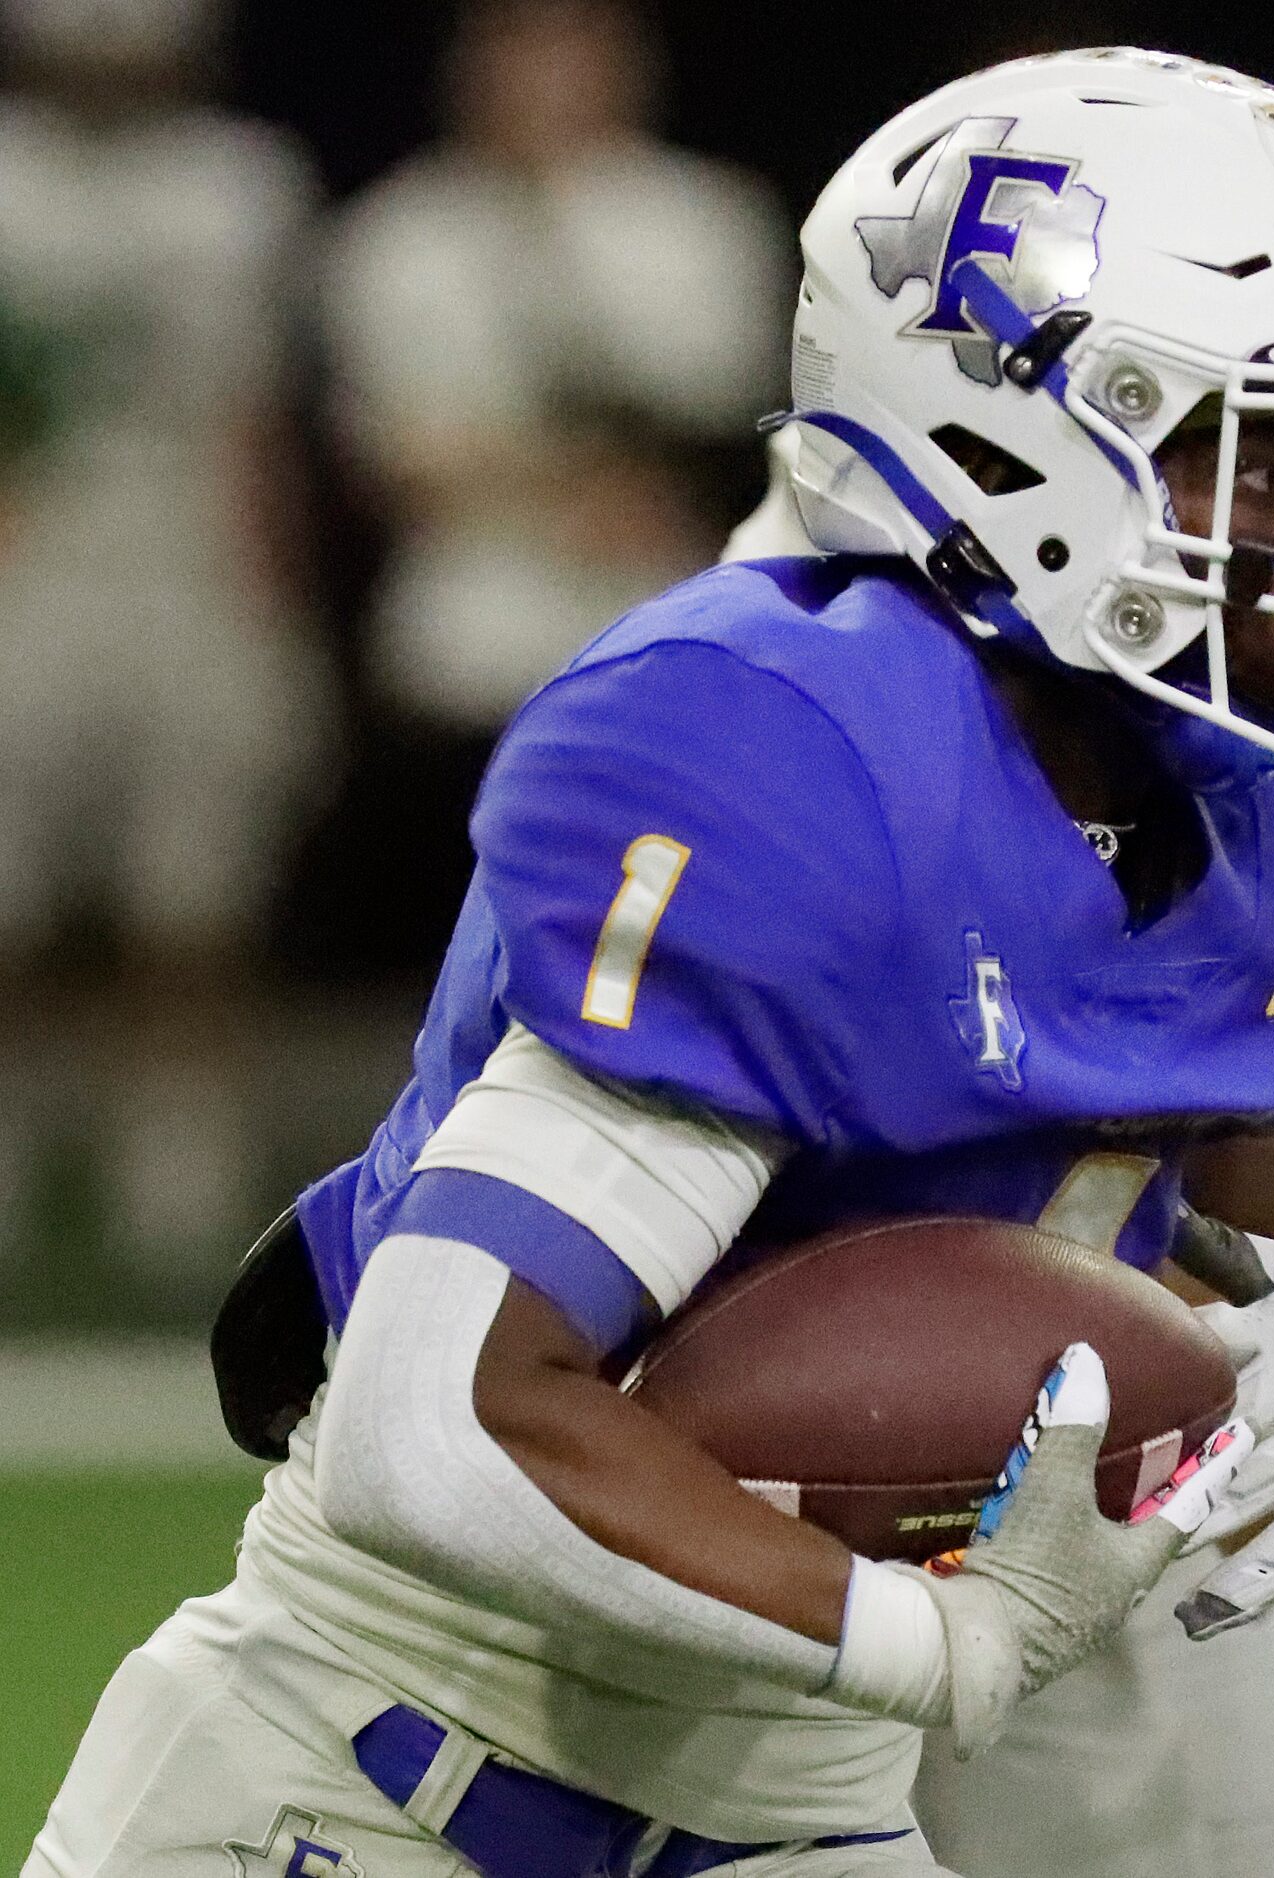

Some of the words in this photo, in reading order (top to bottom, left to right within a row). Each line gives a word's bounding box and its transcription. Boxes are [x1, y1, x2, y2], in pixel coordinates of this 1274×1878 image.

[903, 150, 1080, 340] F
[580, 833, 693, 1031] 1
[974, 957, 1009, 1066] F
